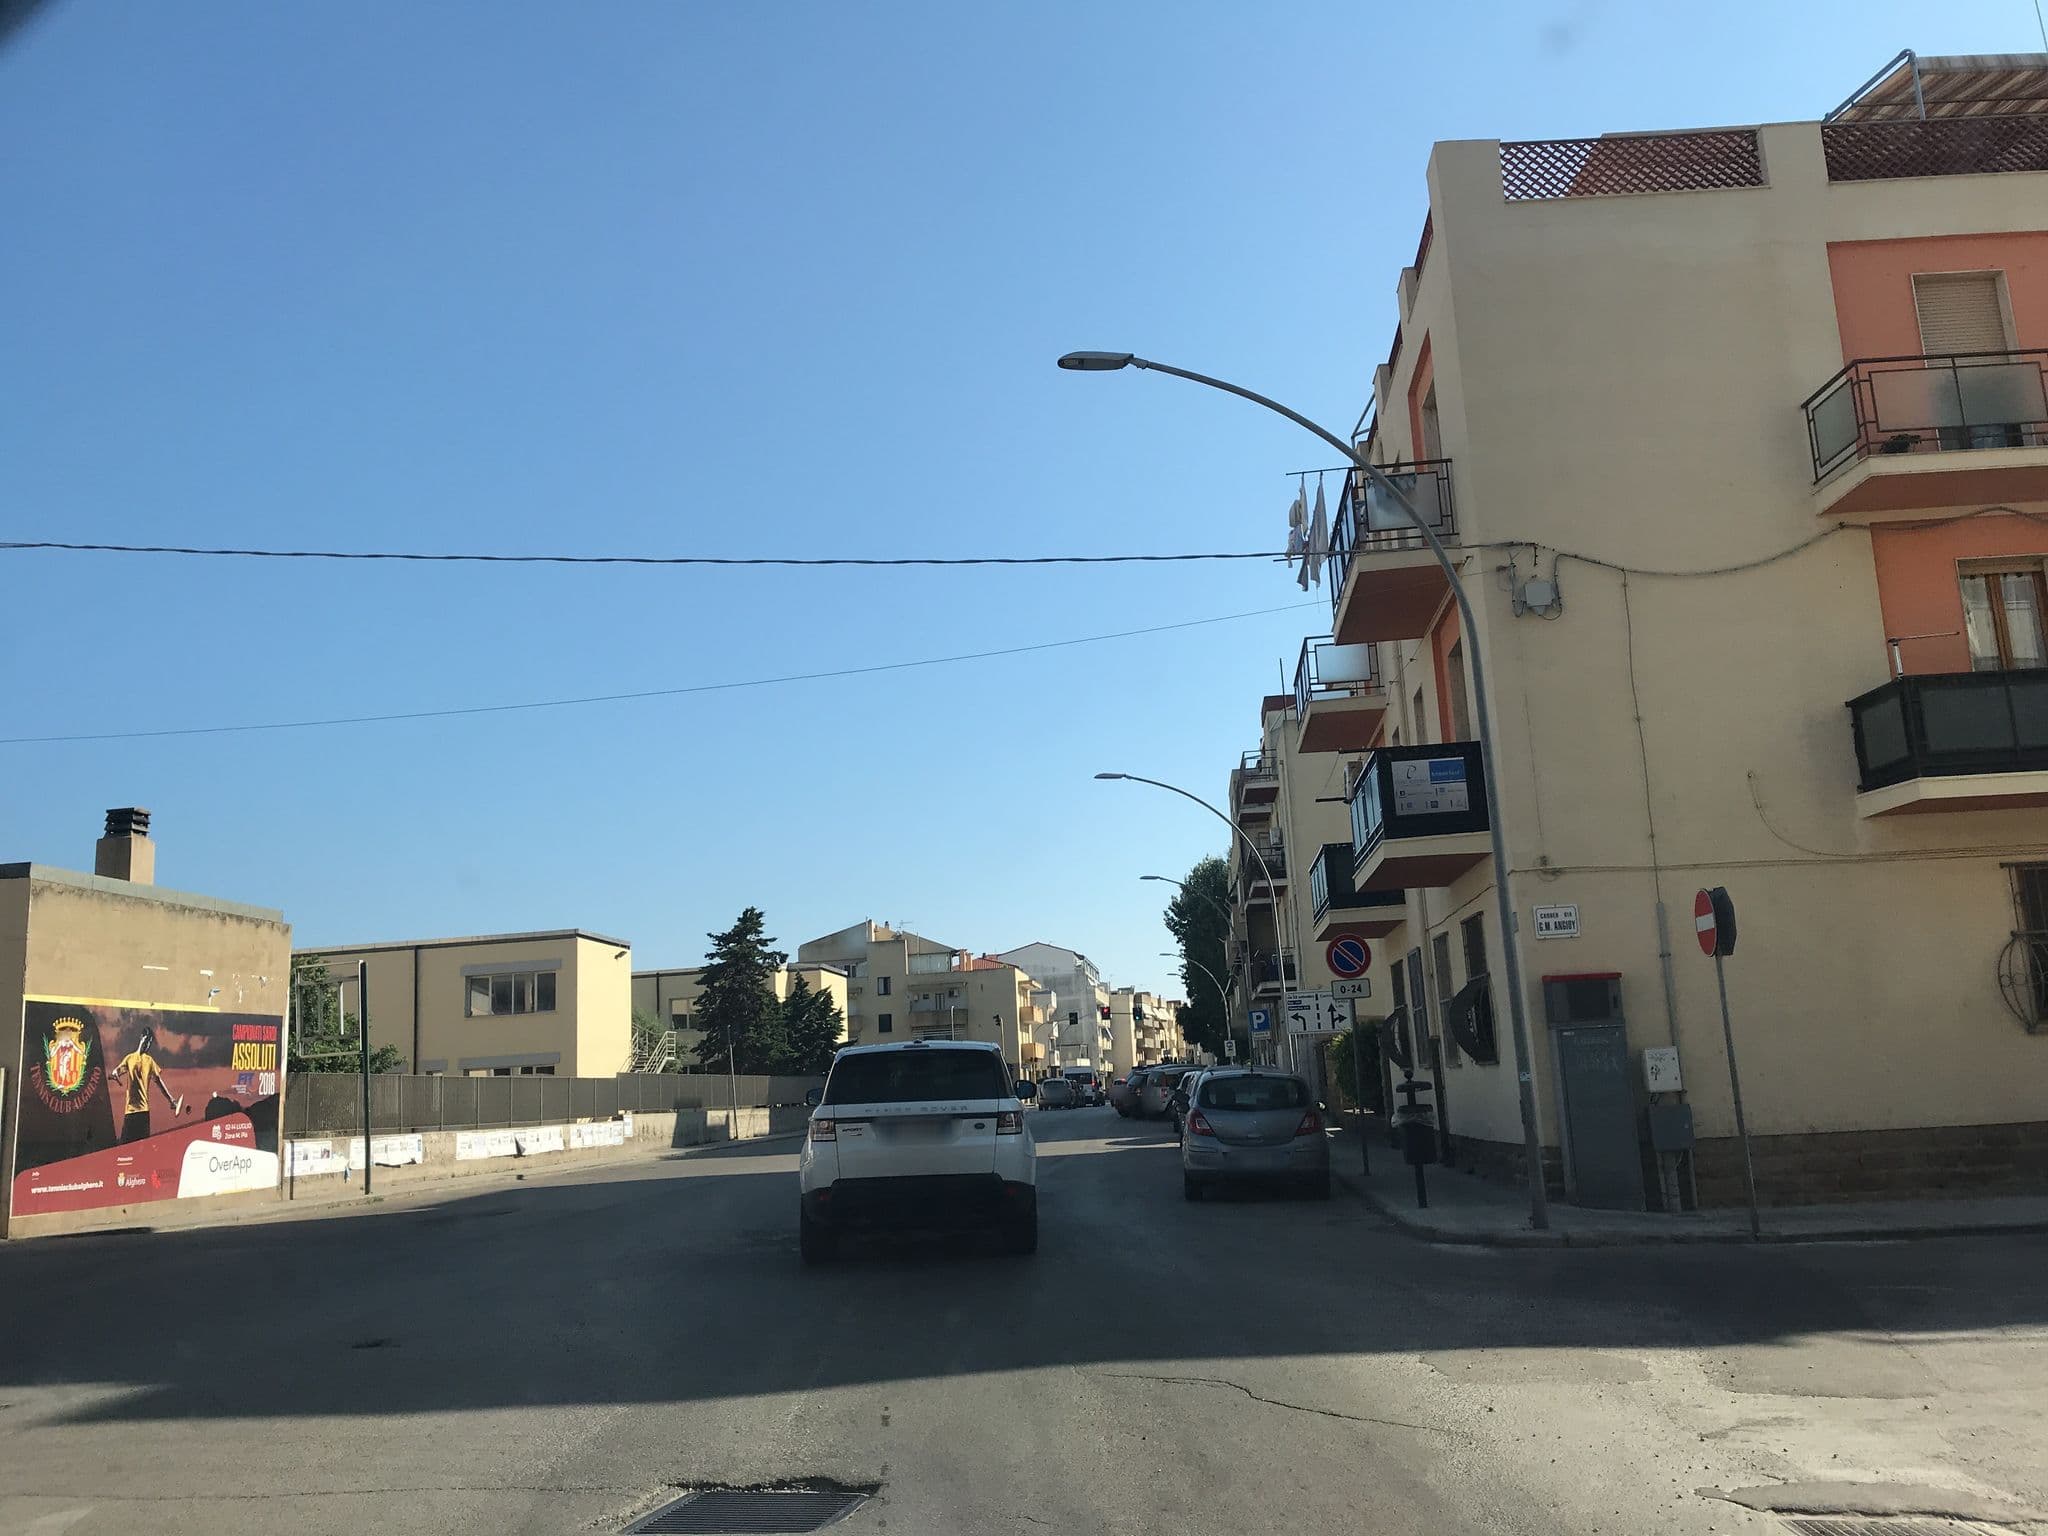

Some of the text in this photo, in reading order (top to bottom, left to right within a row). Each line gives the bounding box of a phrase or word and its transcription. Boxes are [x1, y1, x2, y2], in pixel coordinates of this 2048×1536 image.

[1554, 919, 1576, 931] ANGIOY
[1340, 984, 1362, 994] 0-24
[1252, 1011, 1266, 1029] P
[231, 1043, 276, 1071] ASSOLUTI
[258, 1072, 276, 1096] 2018
[209, 1155, 252, 1175] OverApp
